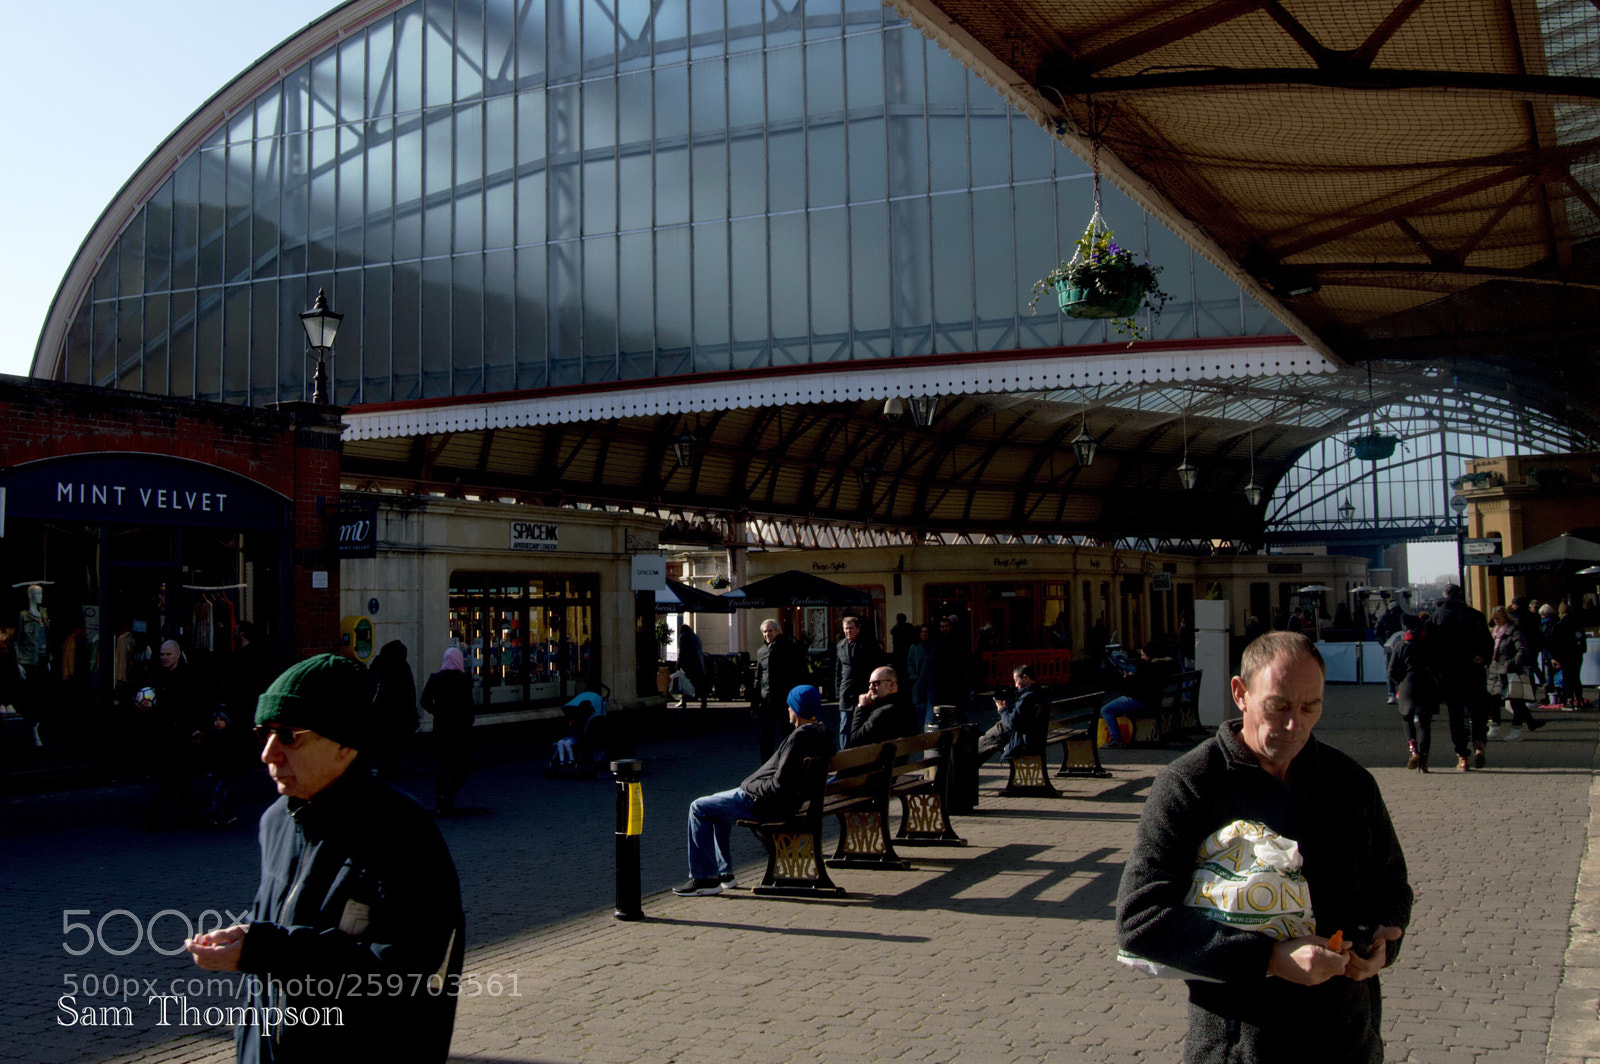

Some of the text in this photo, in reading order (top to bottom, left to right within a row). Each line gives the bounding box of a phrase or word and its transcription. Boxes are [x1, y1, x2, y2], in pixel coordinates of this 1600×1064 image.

[57, 481, 228, 512] MINT VELVET
[1503, 565, 1516, 573] ALL
[1534, 563, 1551, 571] ONE
